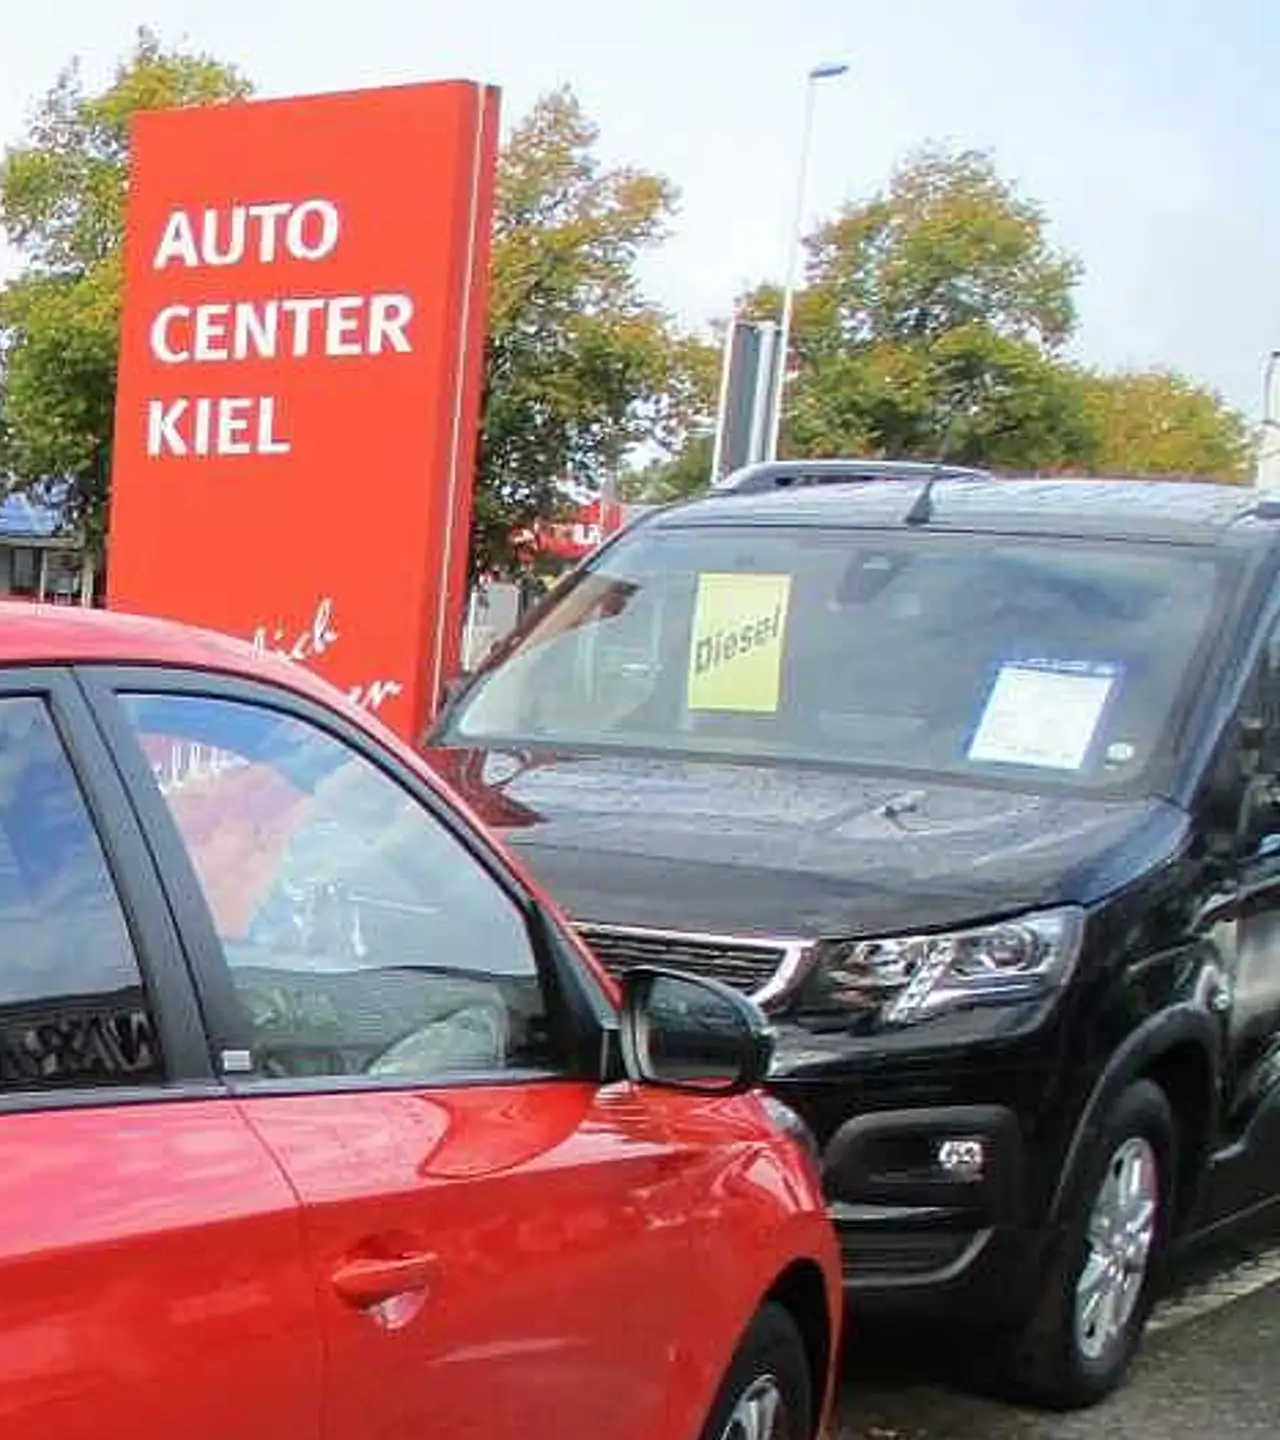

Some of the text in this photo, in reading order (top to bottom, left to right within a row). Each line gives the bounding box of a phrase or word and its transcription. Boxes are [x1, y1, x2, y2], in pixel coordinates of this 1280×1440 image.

[152, 199, 340, 271] AUTO
[149, 292, 416, 364] CENTER
[146, 395, 292, 457] KIEL
[695, 602, 781, 676] Diesel
